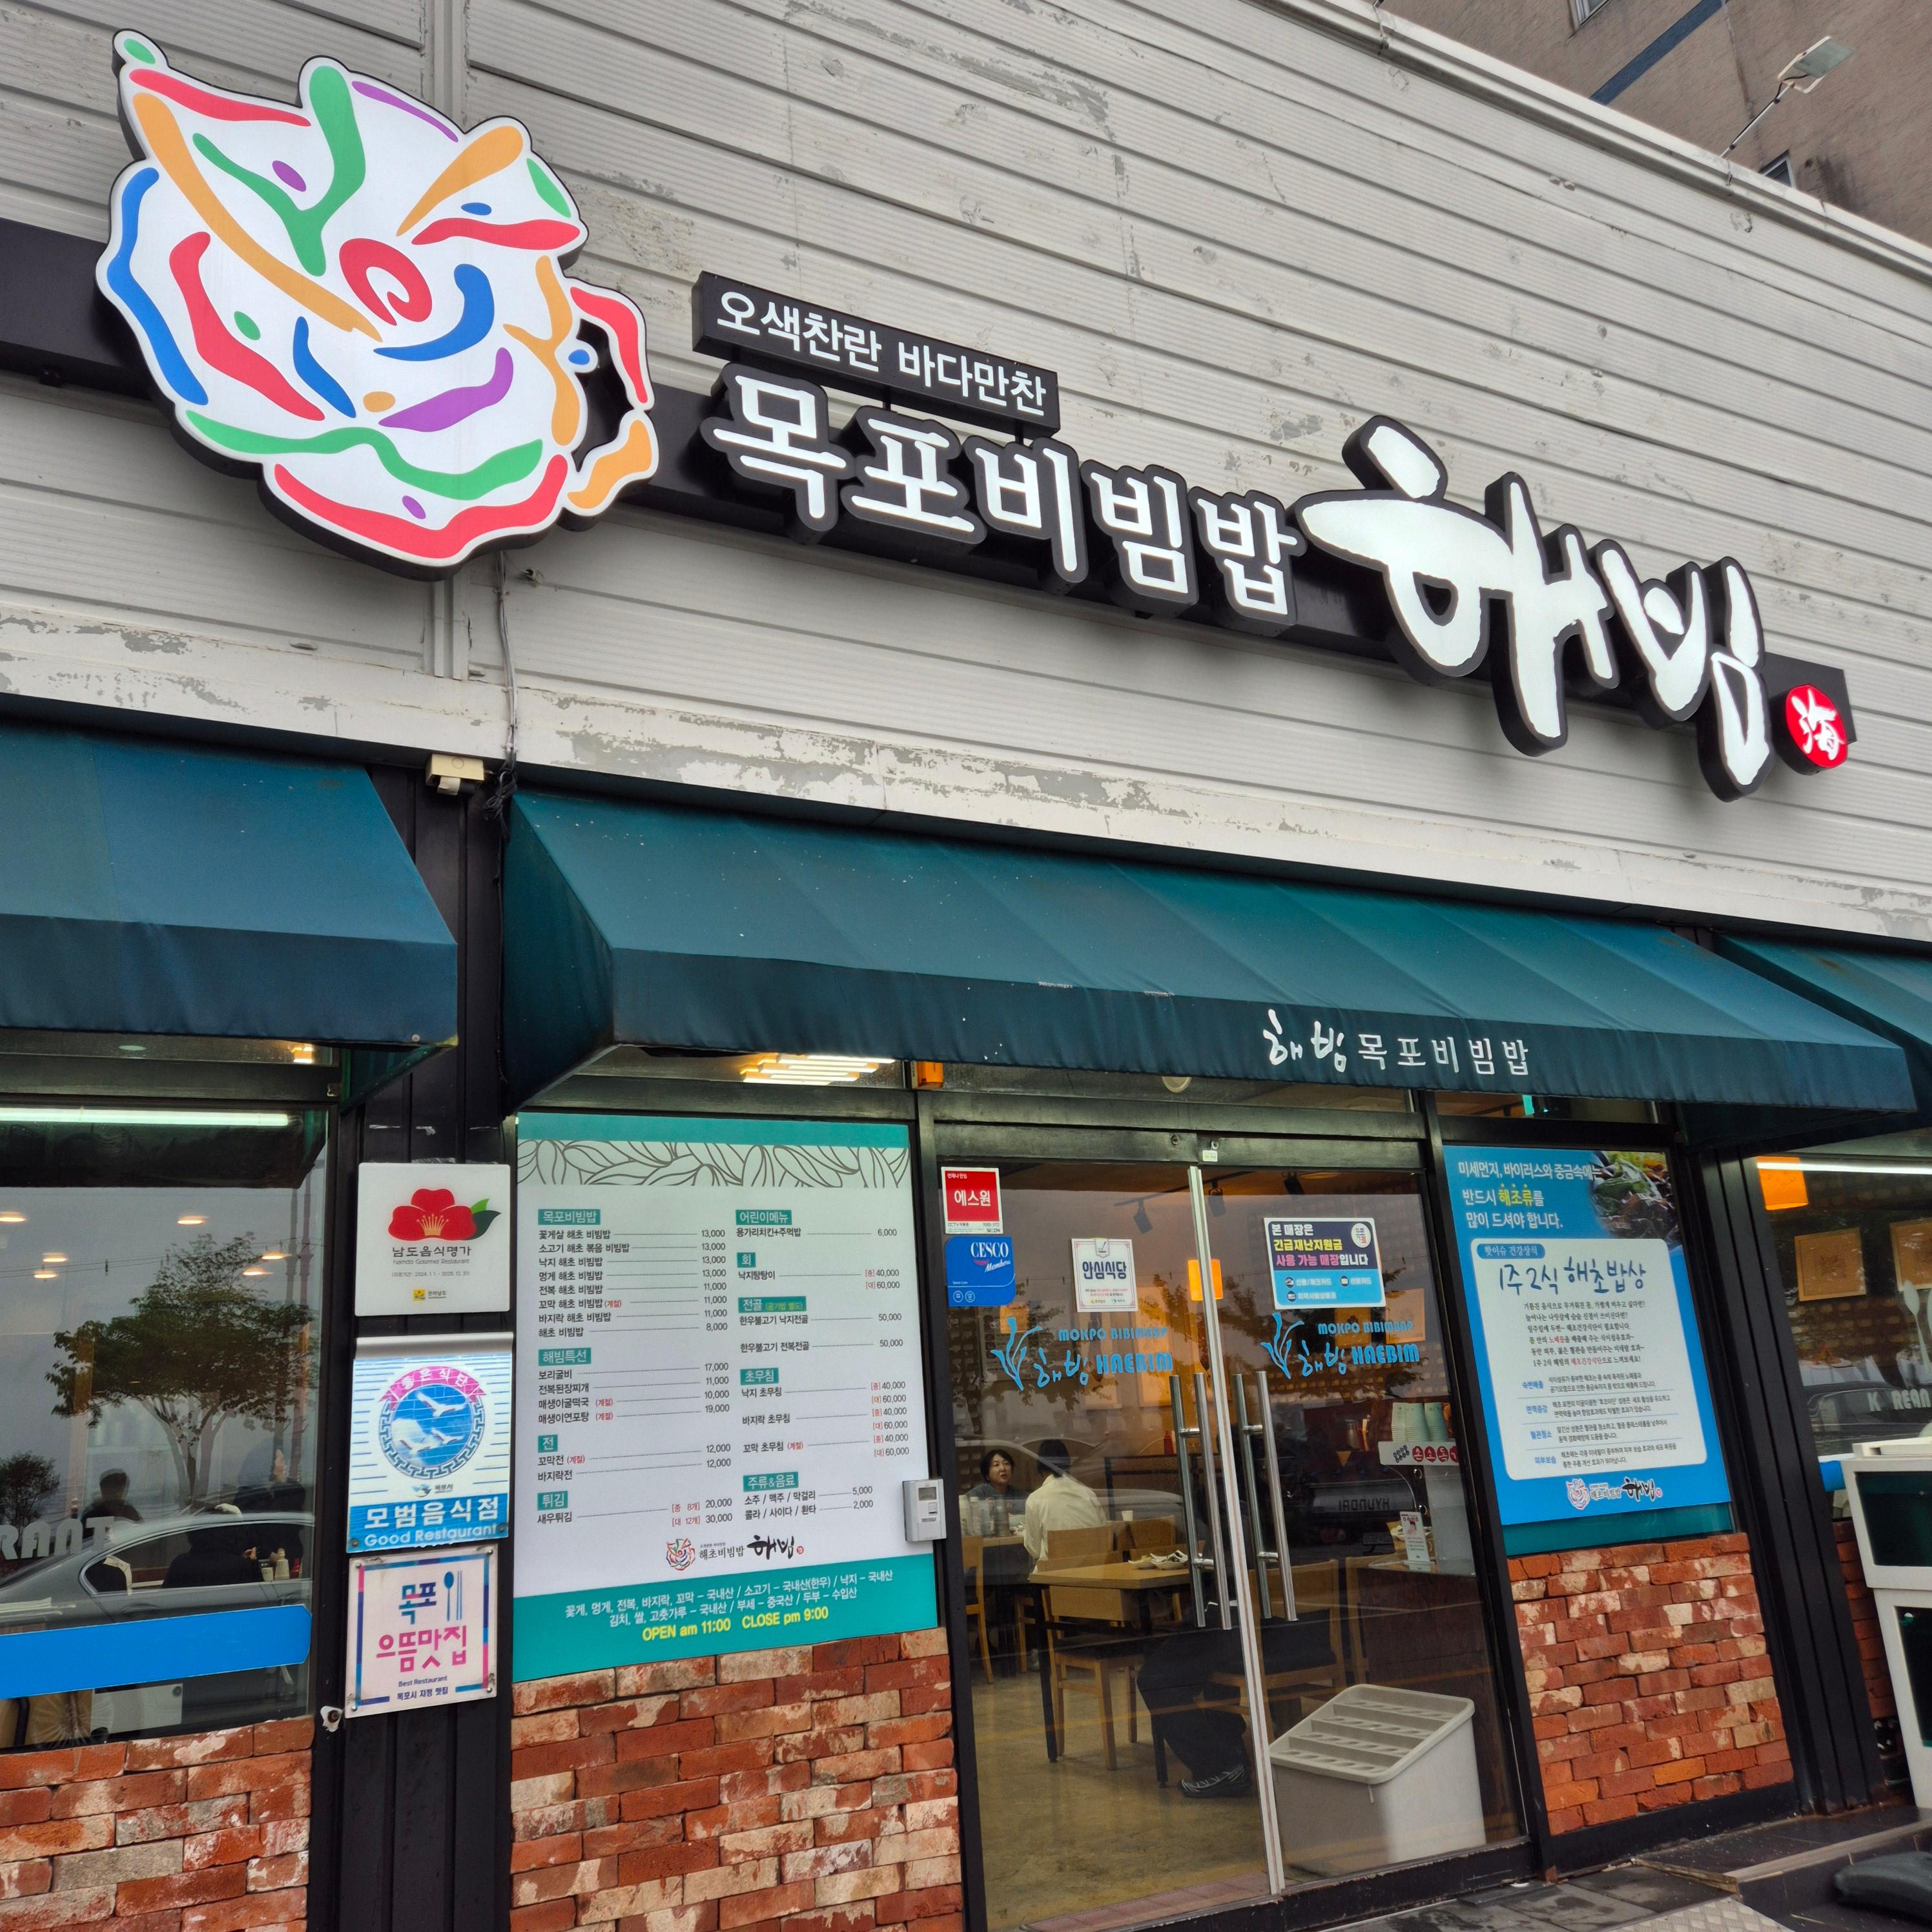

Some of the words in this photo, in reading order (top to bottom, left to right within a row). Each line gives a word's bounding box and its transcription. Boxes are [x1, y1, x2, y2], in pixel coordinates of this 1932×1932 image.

[717, 291, 881, 371] 오색찬란
[898, 342, 1046, 416] 바다만찬
[713, 375, 1297, 616] 목포비빔밥
[1300, 424, 1771, 786] 해빔
[1359, 1034, 1528, 1075] 목포비빔밥
[1458, 1161, 1501, 1179] 미세먼지,
[1503, 1164, 1552, 1179] 바이러스와
[1554, 1164, 1603, 1180] 중금속에는
[954, 1190, 991, 1206] 에스원
[1463, 1189, 1496, 1206] 반드시
[1498, 1189, 1544, 1207] 해조류를
[542, 1211, 597, 1223] 목포비빔밥
[739, 1211, 788, 1224] 어린이메뉴
[1466, 1213, 1488, 1229] 많이
[1492, 1213, 1525, 1228] 드셔야
[1526, 1213, 1563, 1229] 합니다.
[539, 1230, 563, 1240] 꽃게살
[567, 1230, 582, 1239] 해초
[586, 1229, 610, 1239] 비빔밥
[701, 1230, 725, 1238] 13,000
[737, 1228, 801, 1237] 용가리치킨+주먹밥
[1271, 1224, 1282, 1236] 본
[1284, 1224, 1313, 1236] 매장은
[393, 1246, 471, 1257] 남도음식명가
[539, 1244, 564, 1253] 소고기
[567, 1244, 583, 1253] 해초
[586, 1244, 602, 1253] 볶음
[606, 1244, 629, 1253] 비빔밥
[701, 1243, 725, 1251] 13,000
[971, 1242, 1009, 1257] CESCO
[1273, 1239, 1342, 1251] 긴급재난지원금
[1484, 1246, 1506, 1255] 핫이슈
[1509, 1245, 1538, 1256] 건강상식
[539, 1258, 555, 1267] 낙지
[559, 1257, 575, 1266] 해초
[579, 1257, 602, 1266] 비빔밥
[702, 1256, 726, 1264] 13,000
[741, 1254, 751, 1266] 회
[984, 1259, 1011, 1273] Members
[1277, 1255, 1295, 1266] 사용
[1298, 1254, 1317, 1266] 가능
[1320, 1254, 1368, 1266] 매장입니다
[739, 1270, 776, 1280] 낙지탕탕이
[876, 1269, 899, 1277] 40,000
[1082, 1261, 1127, 1279] 안심식당
[1499, 1264, 1523, 1296] 1주
[1526, 1264, 1558, 1295] 2식
[1563, 1256, 1646, 1293] 해초밥상
[743, 1299, 762, 1311] 전골
[739, 1316, 777, 1326] 한우불고기
[779, 1315, 808, 1324] 낙지전골
[878, 1313, 901, 1322] 50,000
[539, 1328, 555, 1337] 해초
[559, 1328, 584, 1337] 비빔밥
[706, 1323, 728, 1331] 8,000
[1058, 1328, 1106, 1341] MOKPO
[1318, 1322, 1359, 1335] MOKPO
[542, 1350, 587, 1363] 해빔특선
[1351, 1343, 1420, 1364] HAEBIM
[1096, 1353, 1173, 1374] HAEBIM
[539, 1370, 572, 1380] 보리굴비
[704, 1363, 728, 1372] 17,000
[745, 1370, 774, 1382] 초무침
[539, 1383, 589, 1395] 전복된장찌개
[706, 1377, 729, 1385] 11,000
[742, 1389, 757, 1398] 낙지
[759, 1387, 782, 1397] 초무침
[882, 1381, 905, 1390] 40,000
[539, 1398, 589, 1410] 매생이굴떡국
[704, 1390, 730, 1399] 10,000
[542, 1437, 553, 1450] 전
[538, 1455, 564, 1466] 꼬막전
[567, 1455, 585, 1464] (계절)
[706, 1444, 731, 1453] 12,000
[747, 1475, 796, 1489] 주류&음료
[542, 1493, 564, 1508] 튀김
[745, 1495, 760, 1506] 소주
[769, 1494, 784, 1504] 맥주
[794, 1491, 816, 1501] 막걸리
[852, 1486, 872, 1496] 5,000
[364, 1496, 498, 1529] 모범음식점
[537, 1512, 572, 1525] 새우튀김
[706, 1499, 732, 1508] 20,000
[745, 1509, 761, 1521] 콜라
[770, 1506, 792, 1517] 사이다
[801, 1505, 816, 1515] 환타
[853, 1500, 873, 1509] 2,000
[364, 1531, 410, 1547] Good
[415, 1523, 497, 1542] Restaurant
[699, 1545, 745, 1561] 해초비빔밥
[566, 1605, 588, 1618] 꽃게,
[591, 1601, 613, 1614] 멍게,
[617, 1599, 638, 1611] 전복,
[642, 1594, 672, 1608] 바지락,
[676, 1592, 694, 1603] 꼬막
[707, 1587, 734, 1601] 국내산
[744, 1583, 770, 1597] 소고기
[840, 1574, 857, 1586] 낙지
[868, 1570, 892, 1582] 국내산
[399, 1582, 437, 1625] 목포
[610, 1614, 631, 1627] 김치,
[635, 1611, 646, 1625] 쌀,
[650, 1607, 687, 1621] 고춧가루
[700, 1601, 727, 1616] 국내산
[737, 1599, 755, 1611] 부세
[767, 1594, 794, 1608] 중국산
[803, 1592, 820, 1603] 두부
[832, 1587, 857, 1600] 수입산
[642, 1625, 676, 1641] OPEN
[680, 1625, 697, 1637] am
[701, 1618, 731, 1634] 11:00
[742, 1611, 780, 1629] CLOSE
[784, 1612, 800, 1625] pm
[804, 1606, 828, 1621] 9:00
[376, 1625, 467, 1672] 으뜸맛집
[414, 1676, 447, 1685] Restaurant
[420, 1689, 433, 1697] 지정
[435, 1687, 448, 1696] 맛집
